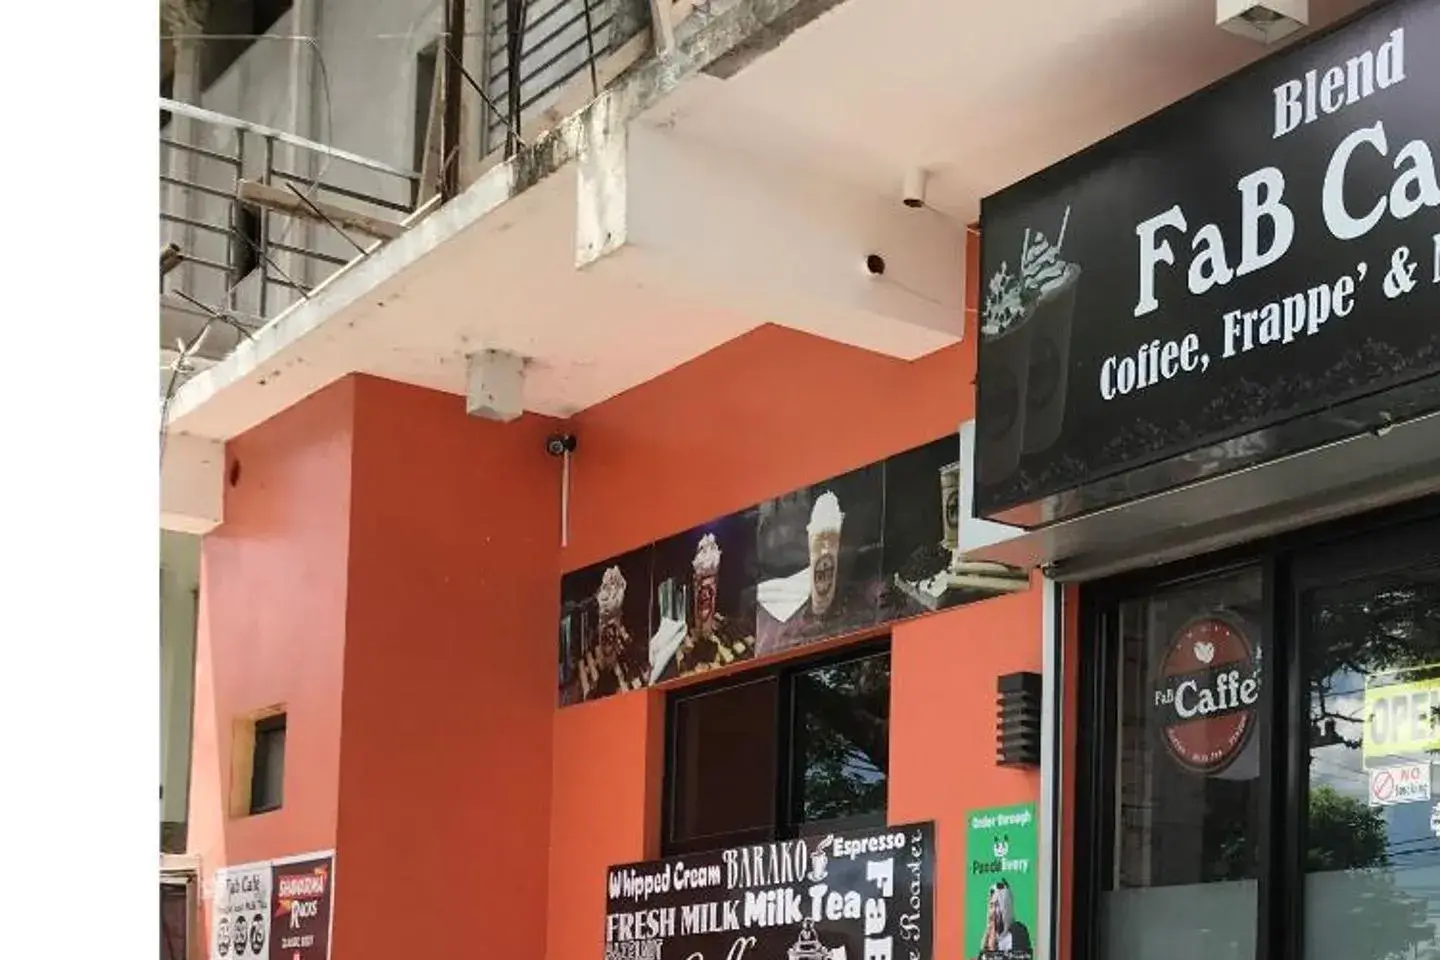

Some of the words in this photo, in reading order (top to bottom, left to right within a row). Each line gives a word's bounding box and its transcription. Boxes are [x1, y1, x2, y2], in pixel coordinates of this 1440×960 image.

[1272, 27, 1406, 140] Blend
[1133, 165, 1295, 317] FaB
[1099, 333, 1210, 401] Coffee,
[1382, 248, 1416, 300] &
[1400, 767, 1420, 781] NO
[722, 839, 807, 889] BARAKO
[833, 832, 906, 860] Espresso
[609, 863, 671, 902] Whipped
[673, 861, 721, 891] Cream
[606, 906, 677, 941] FRESH
[681, 900, 740, 936] MILK
[744, 886, 803, 927] Milk
[808, 883, 861, 922] Tea
